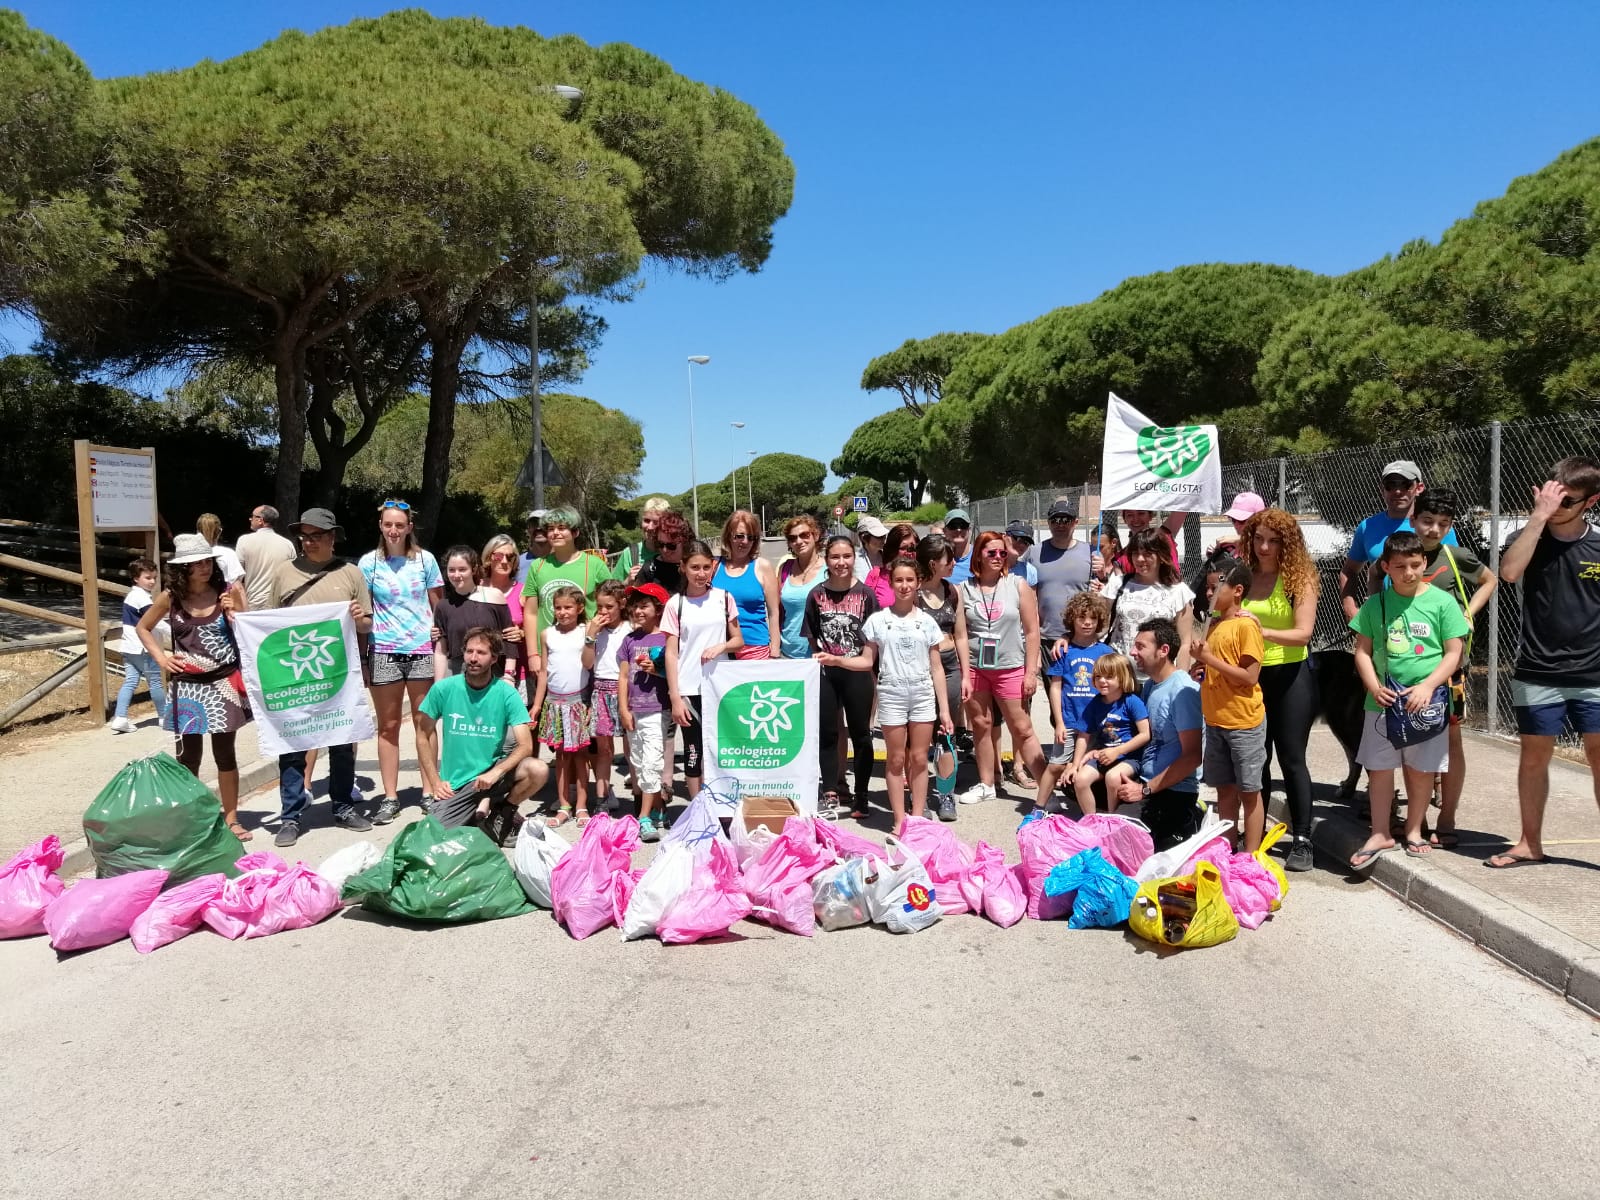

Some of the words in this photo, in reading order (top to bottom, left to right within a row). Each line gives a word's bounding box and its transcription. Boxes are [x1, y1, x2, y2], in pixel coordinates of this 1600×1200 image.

[266, 682, 333, 700] ecologistas
[268, 701, 284, 710] en
[288, 691, 329, 706] acción
[283, 719, 299, 728] Por
[301, 716, 312, 724] un
[314, 708, 345, 722] mundo
[279, 723, 324, 738] sostenible
[325, 722, 331, 731] y
[332, 718, 353, 731] justo
[720, 745, 787, 758] ecologistas
[739, 757, 780, 767] acción
[731, 781, 747, 790] Por
[762, 780, 794, 790] mundo
